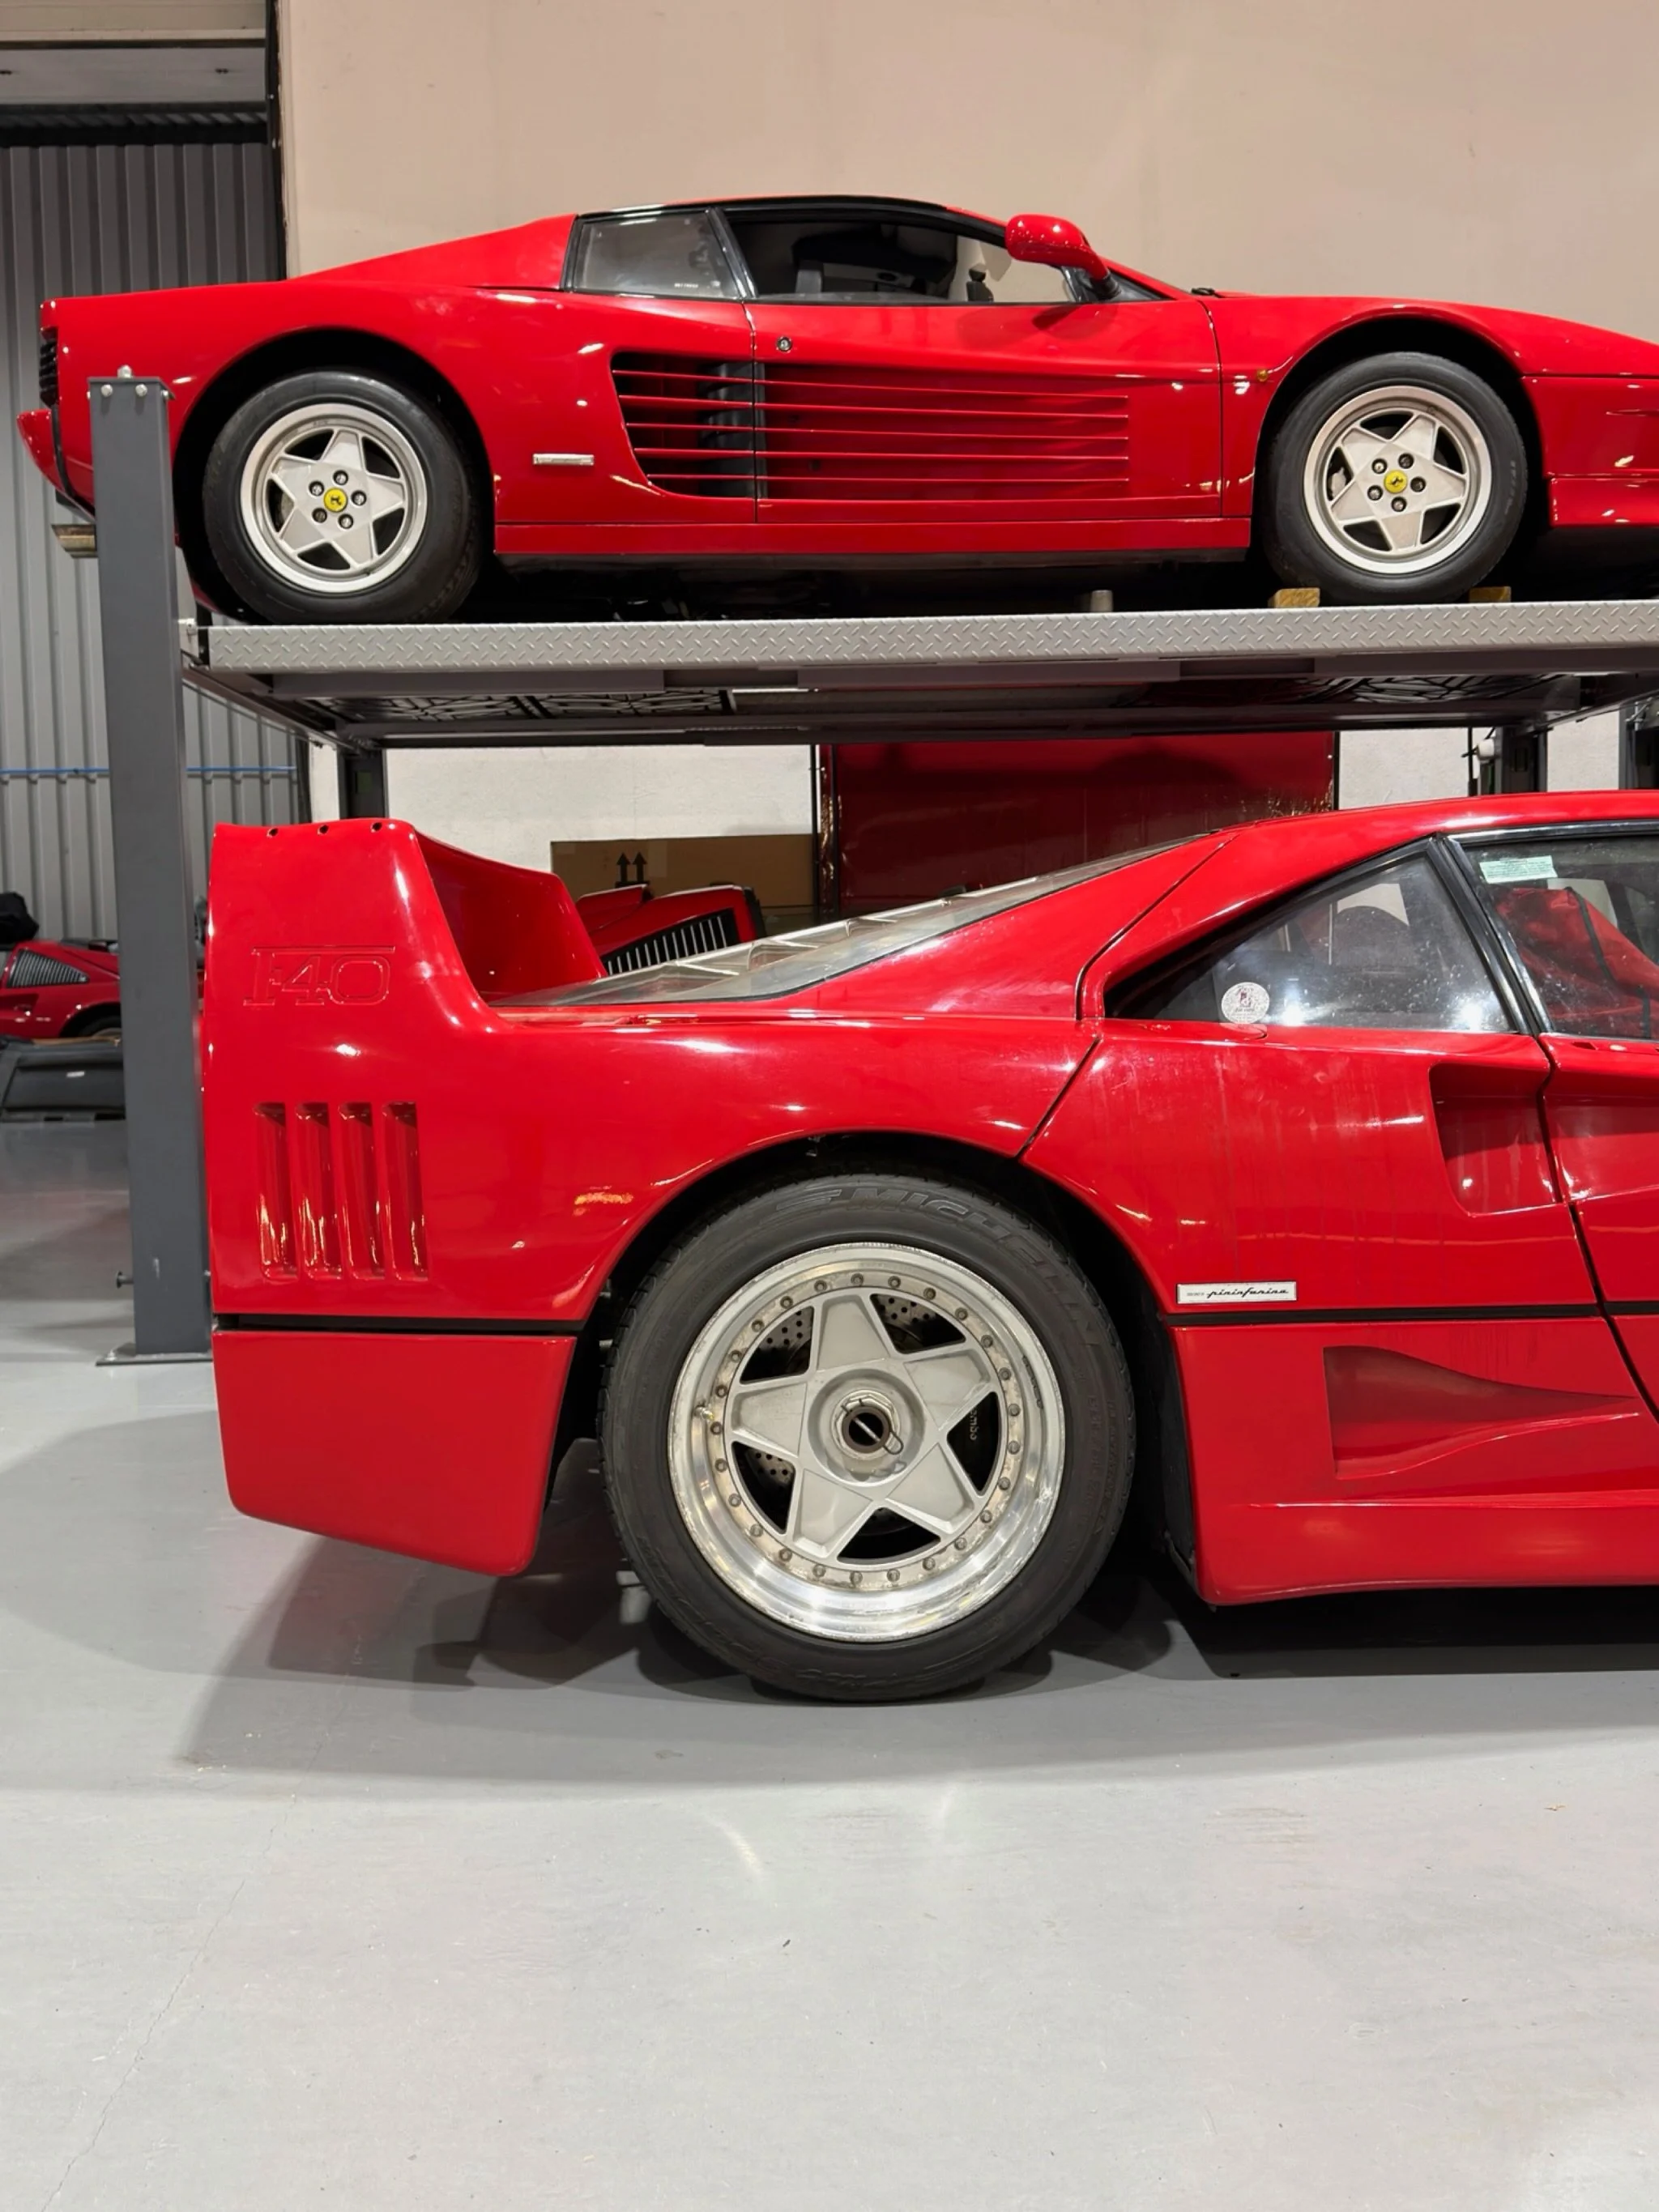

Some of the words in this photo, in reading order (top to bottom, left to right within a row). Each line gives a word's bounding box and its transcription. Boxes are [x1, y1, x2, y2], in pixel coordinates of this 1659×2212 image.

[243, 946, 394, 1006] F40
[847, 1187, 1100, 1347] MICHELIN
[1206, 1286, 1289, 1299] pininfarina
